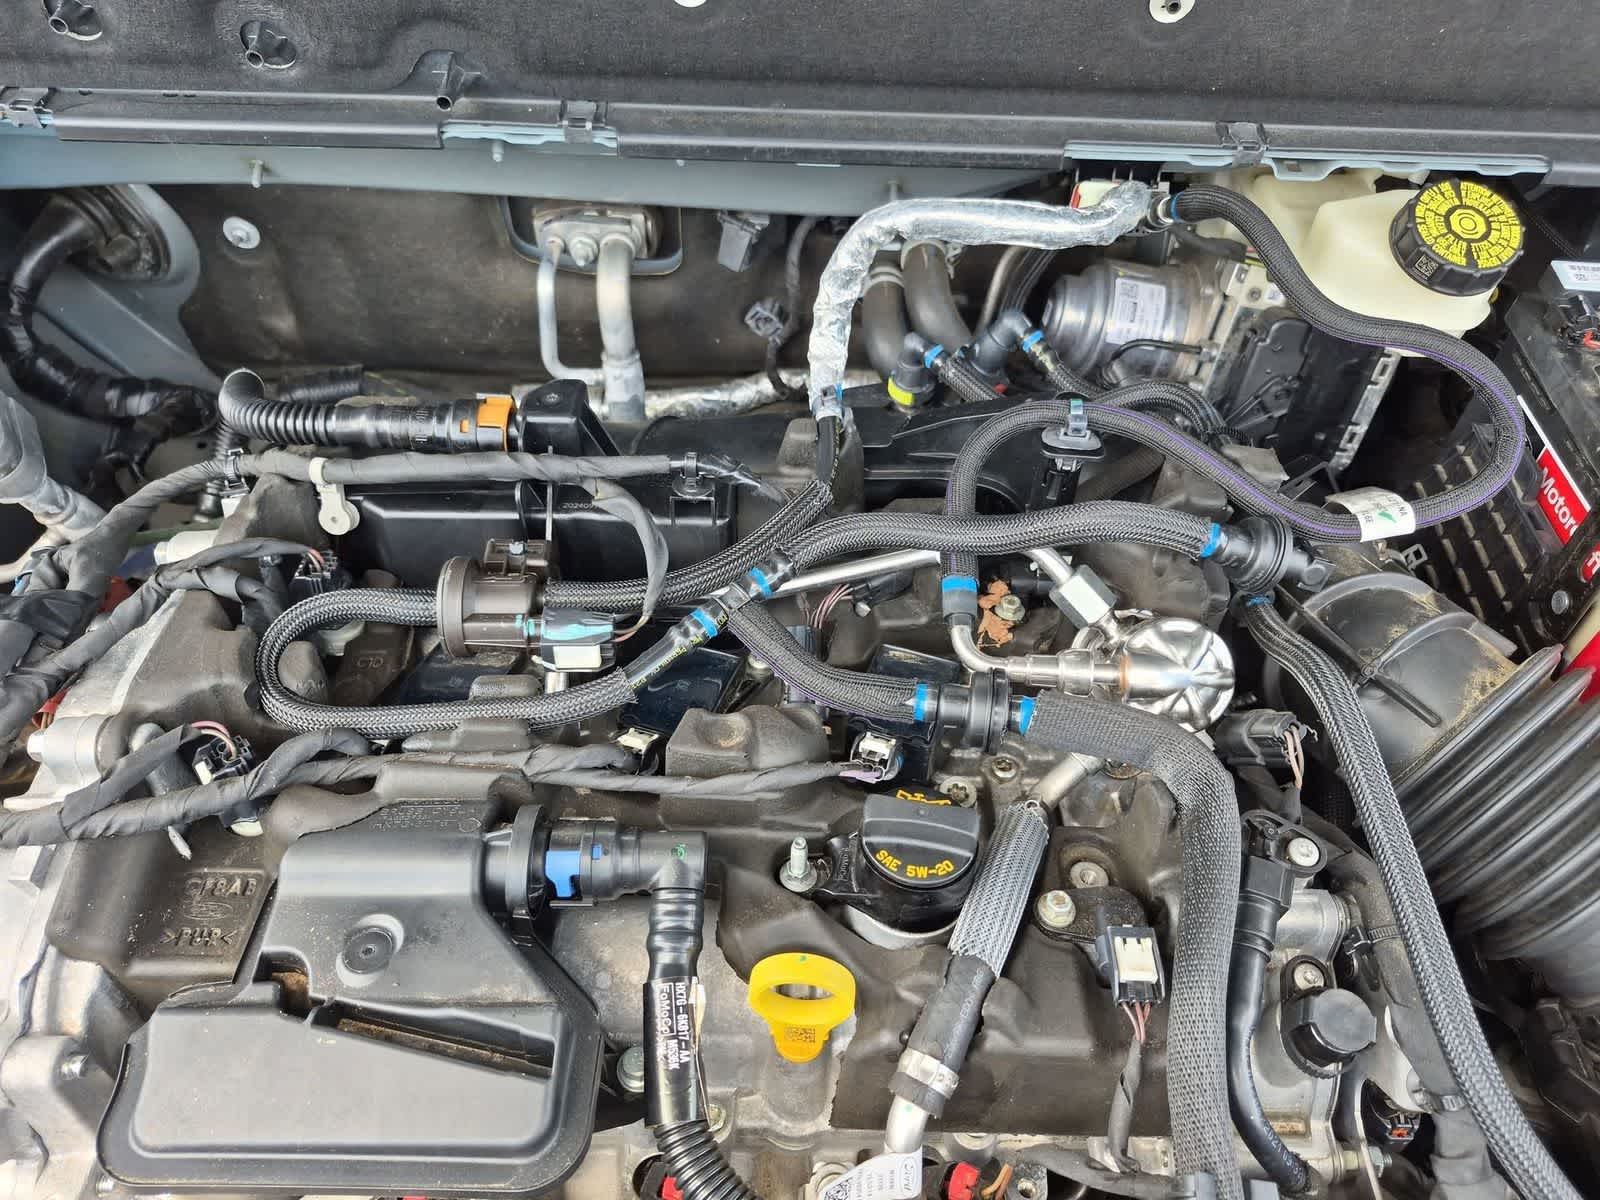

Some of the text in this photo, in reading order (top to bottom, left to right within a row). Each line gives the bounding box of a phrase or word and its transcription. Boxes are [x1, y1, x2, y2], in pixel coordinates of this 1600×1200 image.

[876, 850, 954, 878] SAE 5W-20
[659, 986, 671, 1034] FoMoCo
